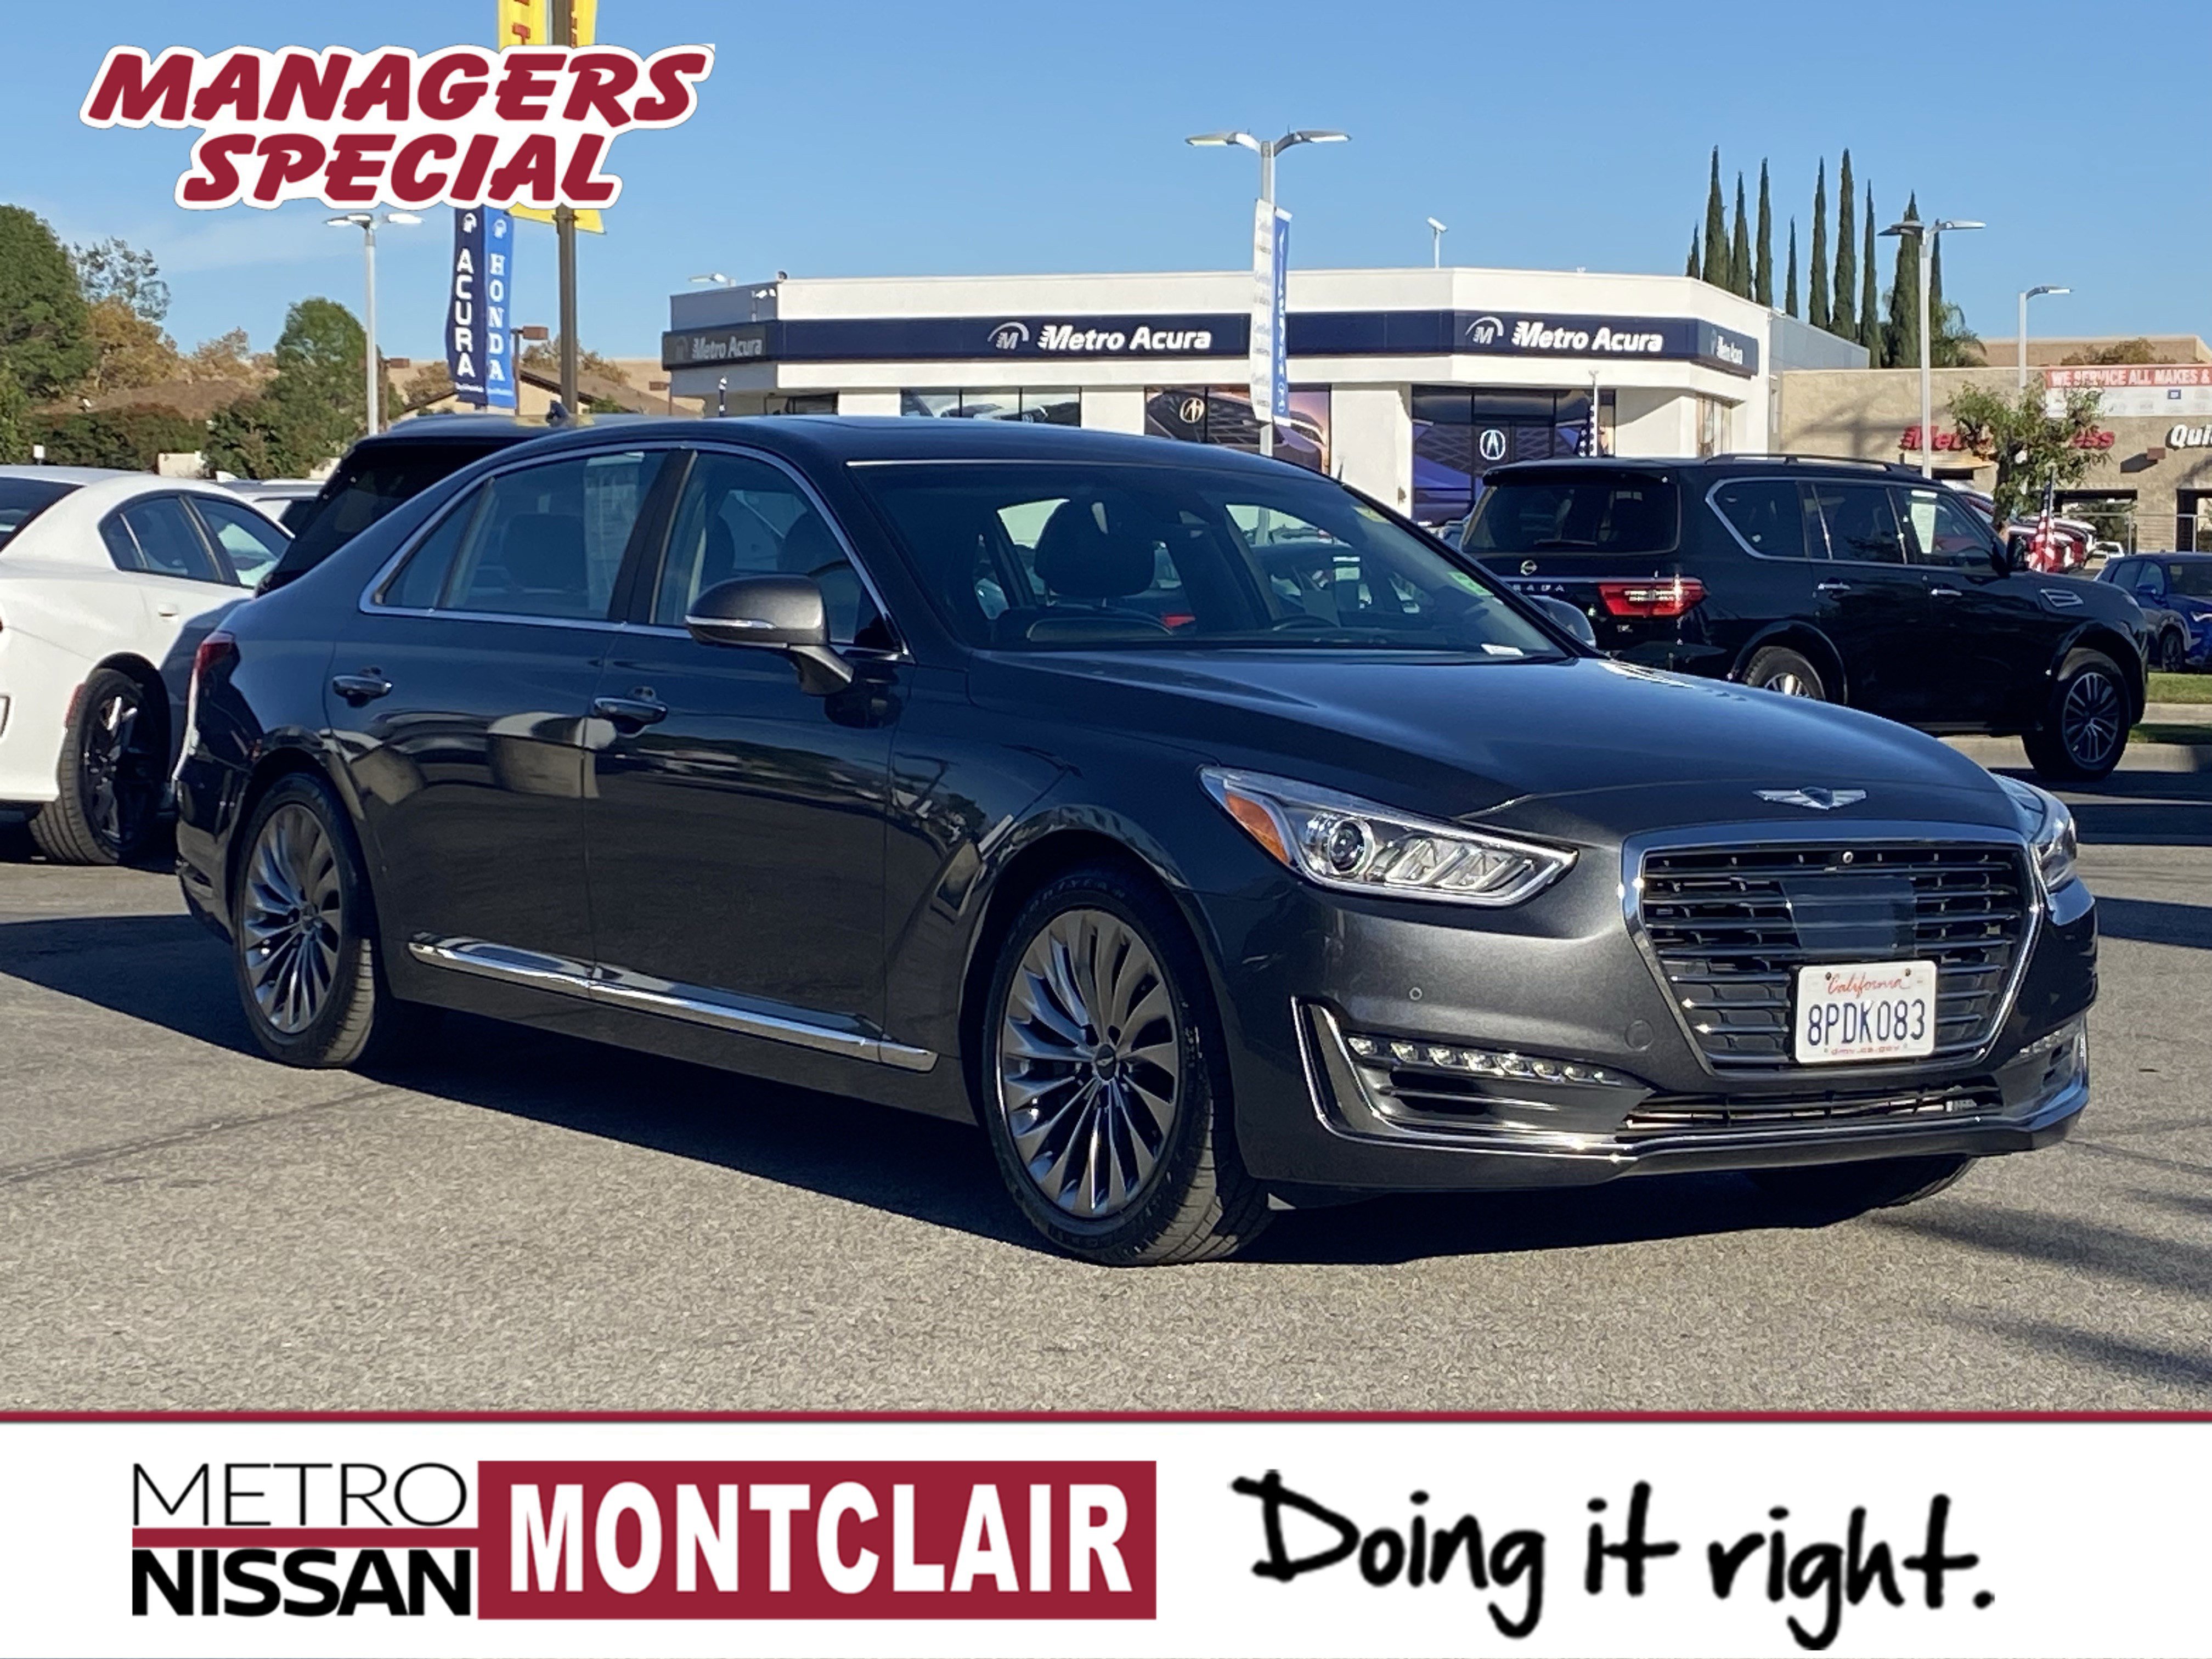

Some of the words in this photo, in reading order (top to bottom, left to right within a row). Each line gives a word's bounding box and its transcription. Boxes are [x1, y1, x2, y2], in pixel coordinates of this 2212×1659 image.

[455, 248, 475, 377] ACURA
[487, 253, 505, 381] HONDA
[692, 336, 727, 360] Metro
[727, 335, 763, 357] Acura
[1037, 325, 1125, 350] Metro
[1128, 326, 1211, 349] Acura
[1511, 321, 1589, 350] Metro
[1592, 327, 1663, 352] Acura
[2051, 370, 2072, 386] WE
[2128, 369, 2152, 385] ALL
[2154, 369, 2198, 385] MAKES
[2200, 369, 2210, 384] &
[2170, 424, 2212, 448] Qui
[1827, 972, 1910, 998] California
[1808, 998, 1925, 1046] 8PDK083
